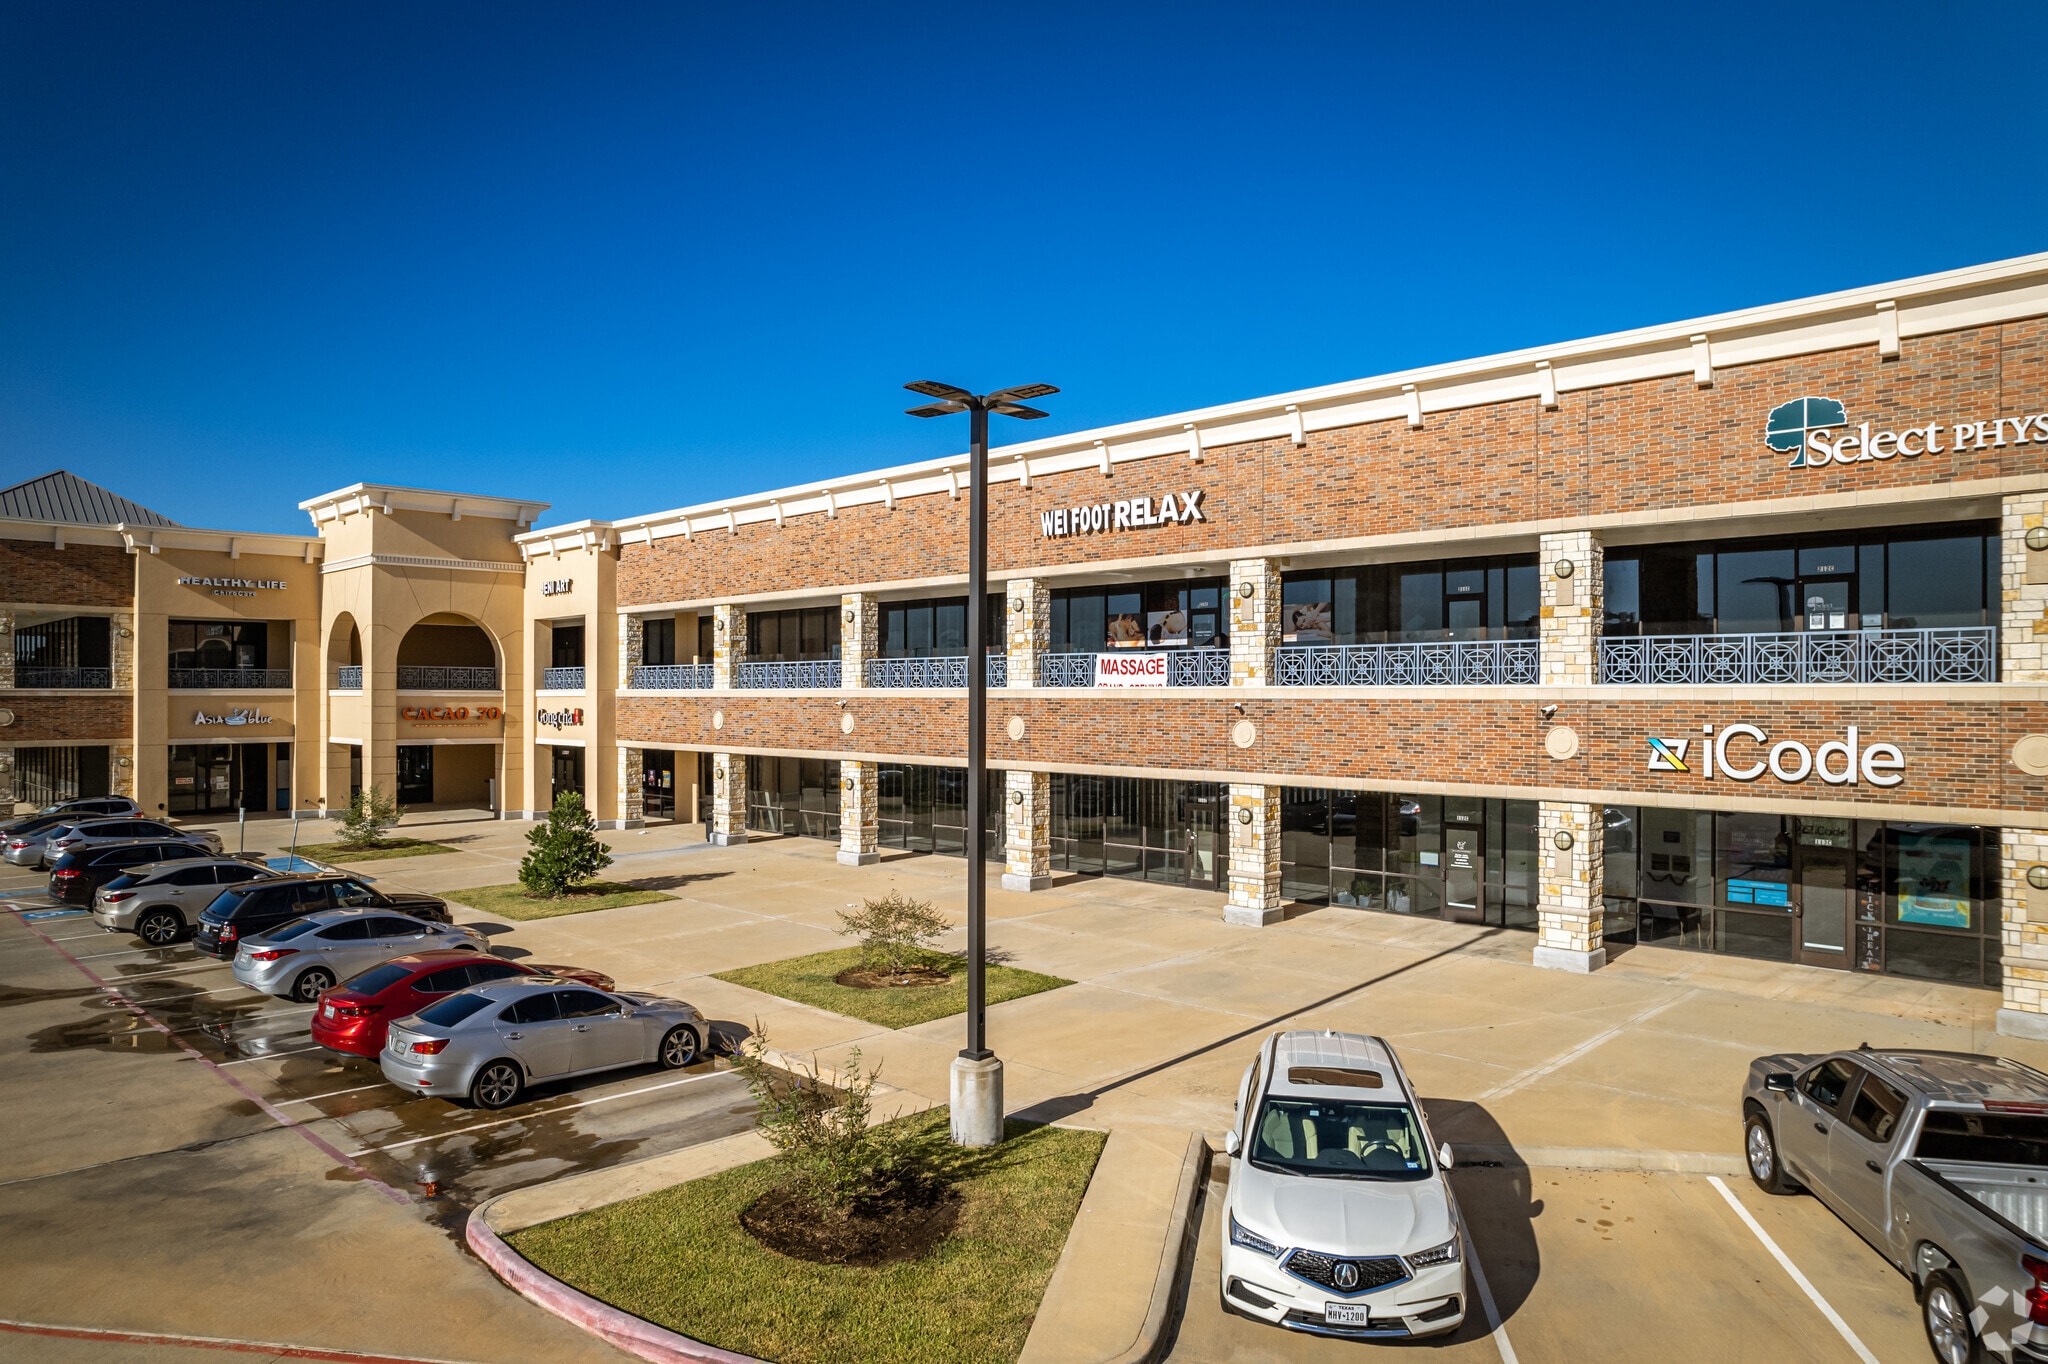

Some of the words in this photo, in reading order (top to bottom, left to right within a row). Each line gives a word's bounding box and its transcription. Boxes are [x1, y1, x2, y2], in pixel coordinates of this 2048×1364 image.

[1807, 421, 1945, 467] Select
[1040, 508, 1068, 537] WEI
[1071, 503, 1111, 533] FOOT
[1114, 490, 1203, 529] RELAX
[178, 576, 252, 588] HEALTHY
[257, 580, 288, 590] LIFE
[555, 578, 571, 593] ART
[1100, 658, 1165, 675] MASSAGE
[247, 707, 273, 724] blue
[402, 706, 470, 721] CACAO
[476, 706, 502, 721] 70
[1702, 723, 1906, 787] iCode
